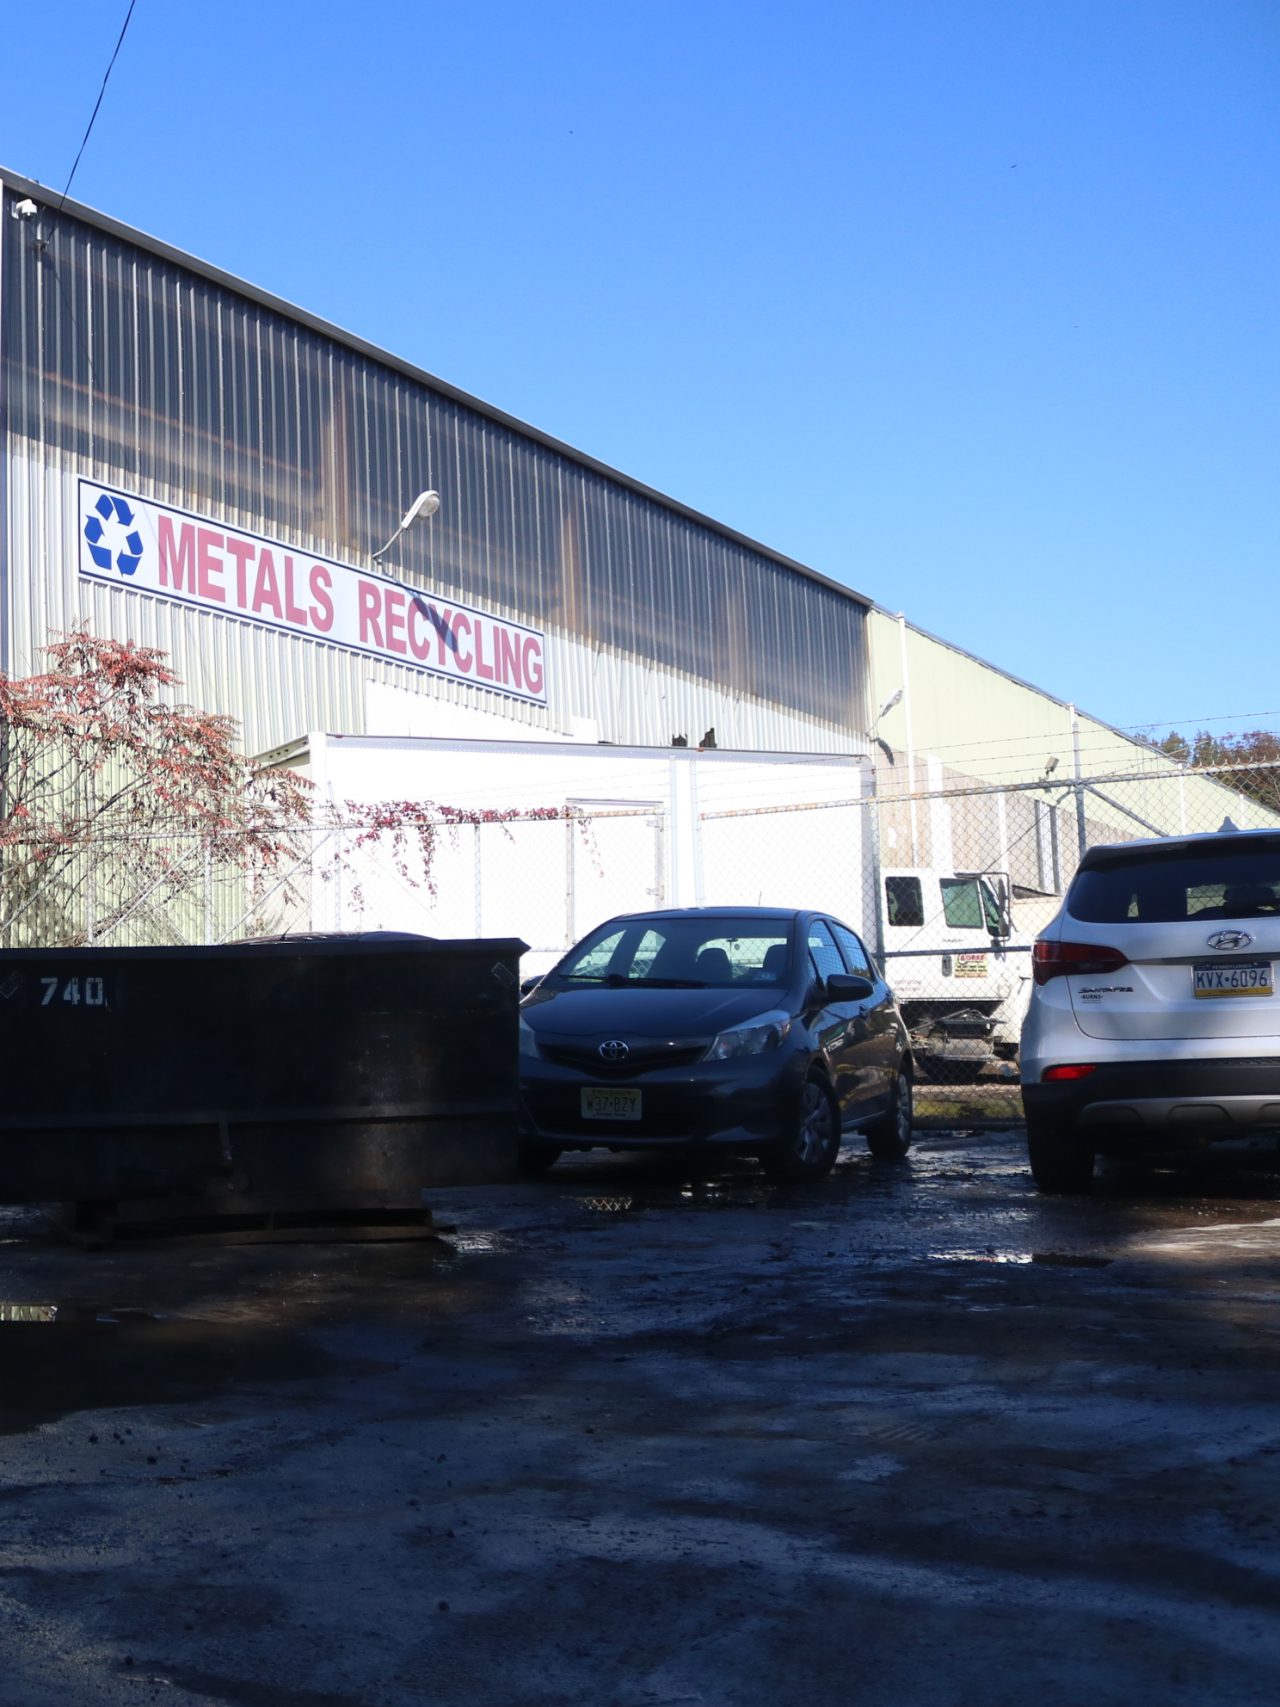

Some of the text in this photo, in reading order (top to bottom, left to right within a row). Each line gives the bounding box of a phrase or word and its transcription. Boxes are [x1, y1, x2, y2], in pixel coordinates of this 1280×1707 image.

[158, 514, 544, 694] METALS RECYCLING
[40, 977, 104, 1006] 740
